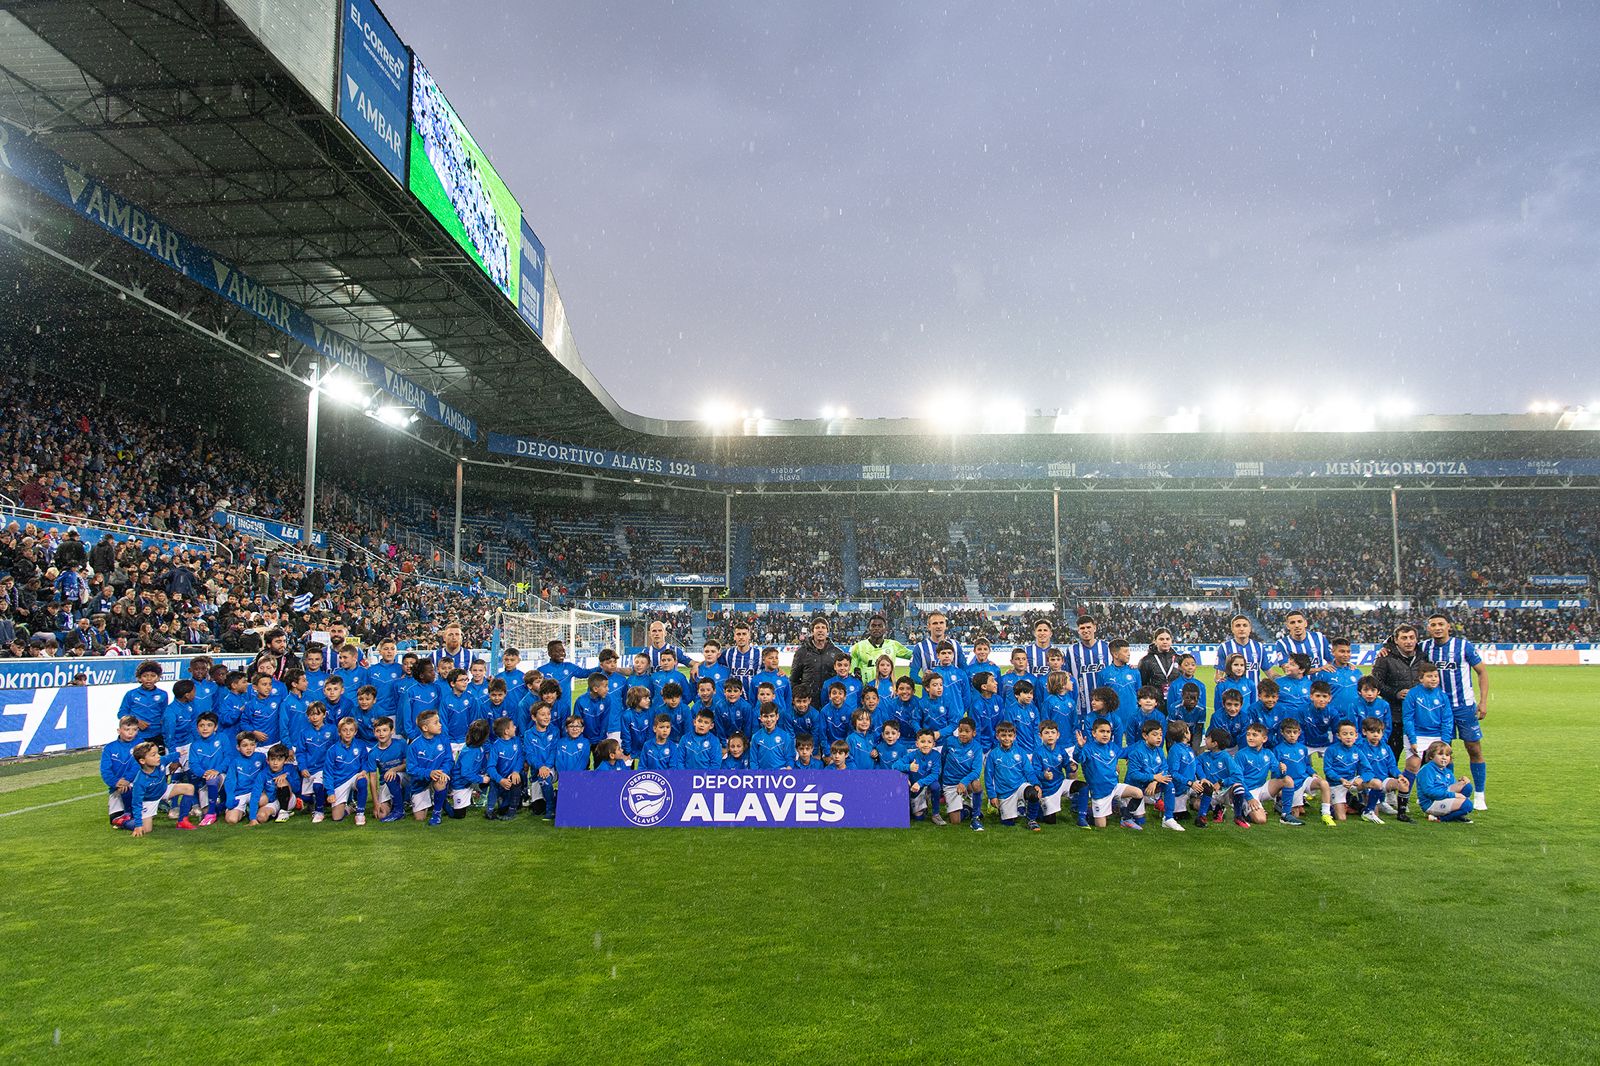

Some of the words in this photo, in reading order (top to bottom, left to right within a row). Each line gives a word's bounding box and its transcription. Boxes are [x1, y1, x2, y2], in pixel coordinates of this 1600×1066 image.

[351, 3, 363, 31] EL
[364, 22, 401, 79] CORREO
[357, 91, 402, 160] AMBAR
[86, 185, 182, 269] AMBAR
[228, 272, 291, 333] AMBAR
[323, 331, 369, 378] AMBAR
[392, 373, 427, 412] AMBAR
[444, 406, 472, 438] AMBAR
[517, 440, 604, 465] DEPORTIVO
[611, 454, 663, 472] ALAVÉS
[669, 462, 697, 477] 1921
[1325, 461, 1468, 476] MENDIZORROTZA
[281, 526, 299, 540] LEA
[311, 532, 321, 544] EA
[655, 574, 672, 583] Audi
[698, 575, 725, 584] Alzaga
[593, 602, 625, 611] CaixaBank
[732, 667, 755, 677] LEA
[1032, 665, 1050, 674] LE
[1080, 663, 1105, 674] LEA
[1245, 661, 1259, 673] EA
[1435, 660, 1458, 671] EA
[0, 686, 89, 759] EA
[629, 774, 666, 787] DEPORTIVO
[692, 774, 797, 790] DEPORTIVO
[680, 784, 845, 822] ALAVÉS
[632, 815, 660, 824] ALAVÉS
